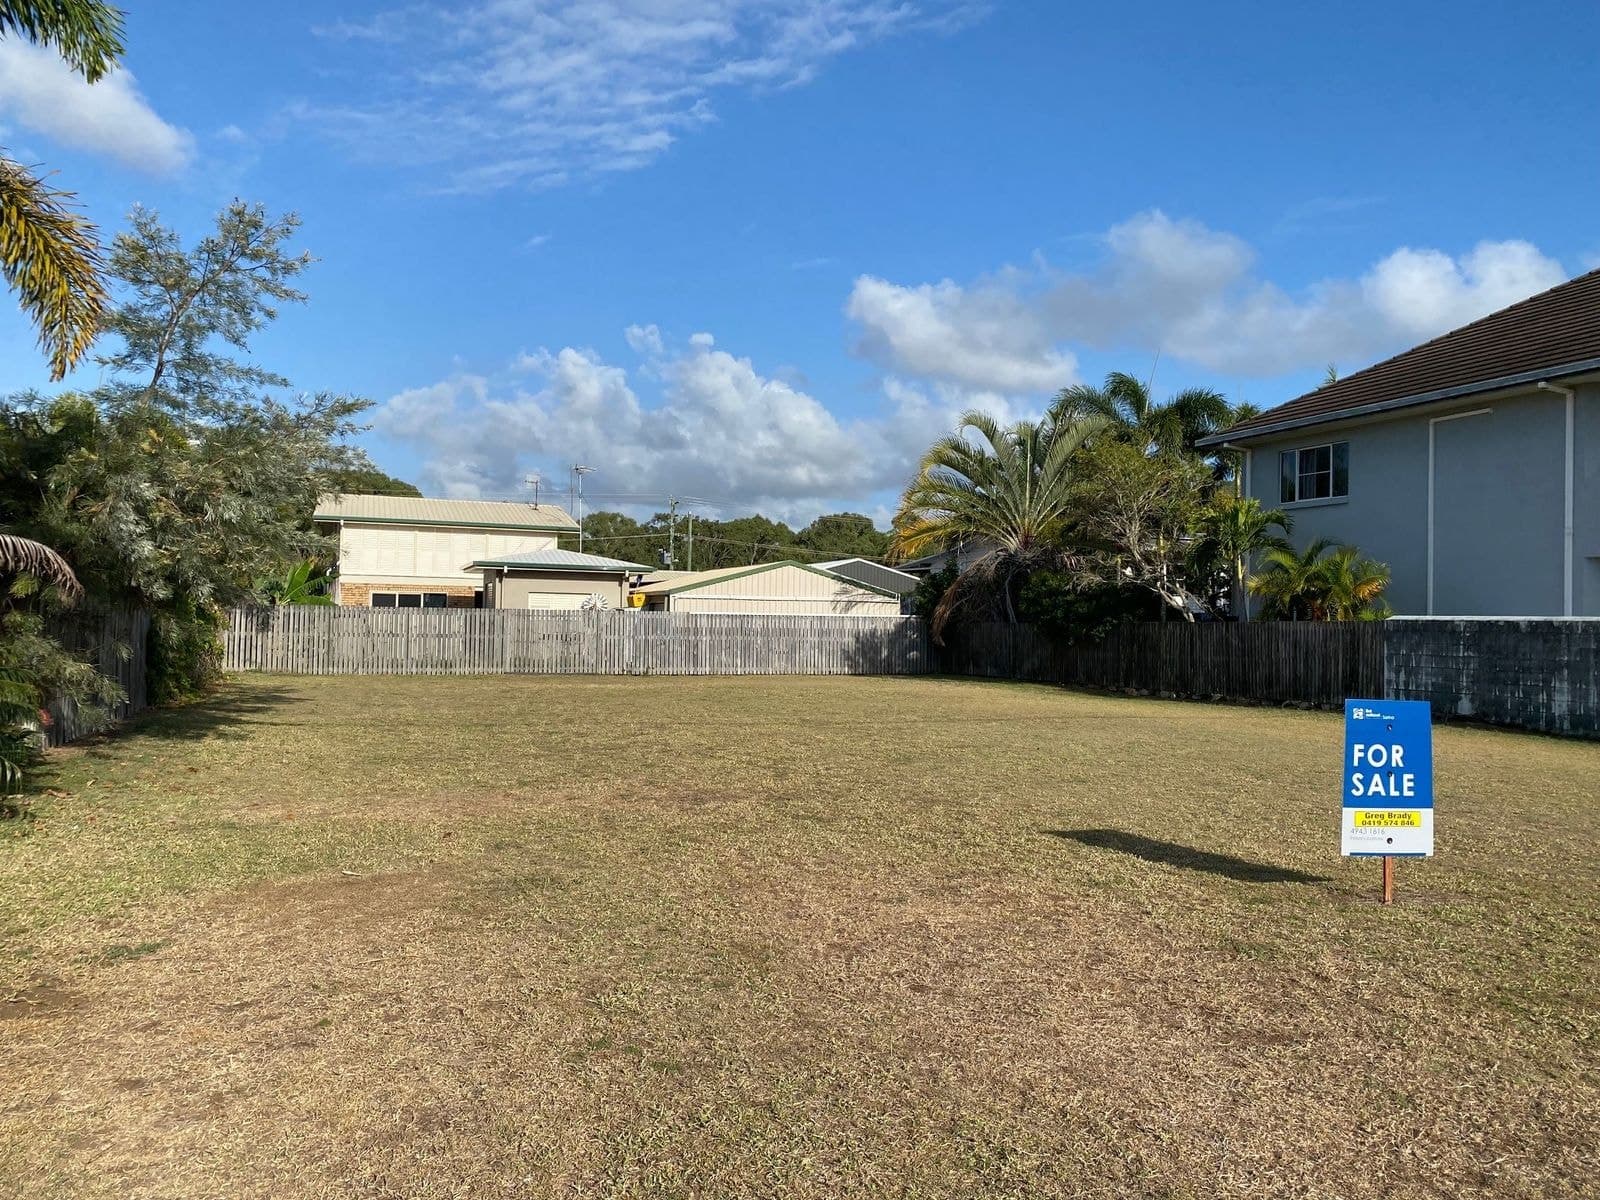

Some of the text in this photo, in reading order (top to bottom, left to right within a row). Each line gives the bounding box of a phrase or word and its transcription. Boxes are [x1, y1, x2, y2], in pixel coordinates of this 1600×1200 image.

[1353, 744, 1404, 767] FOR
[1351, 772, 1415, 797] SALE
[1365, 812, 1412, 820] Greg Brady
